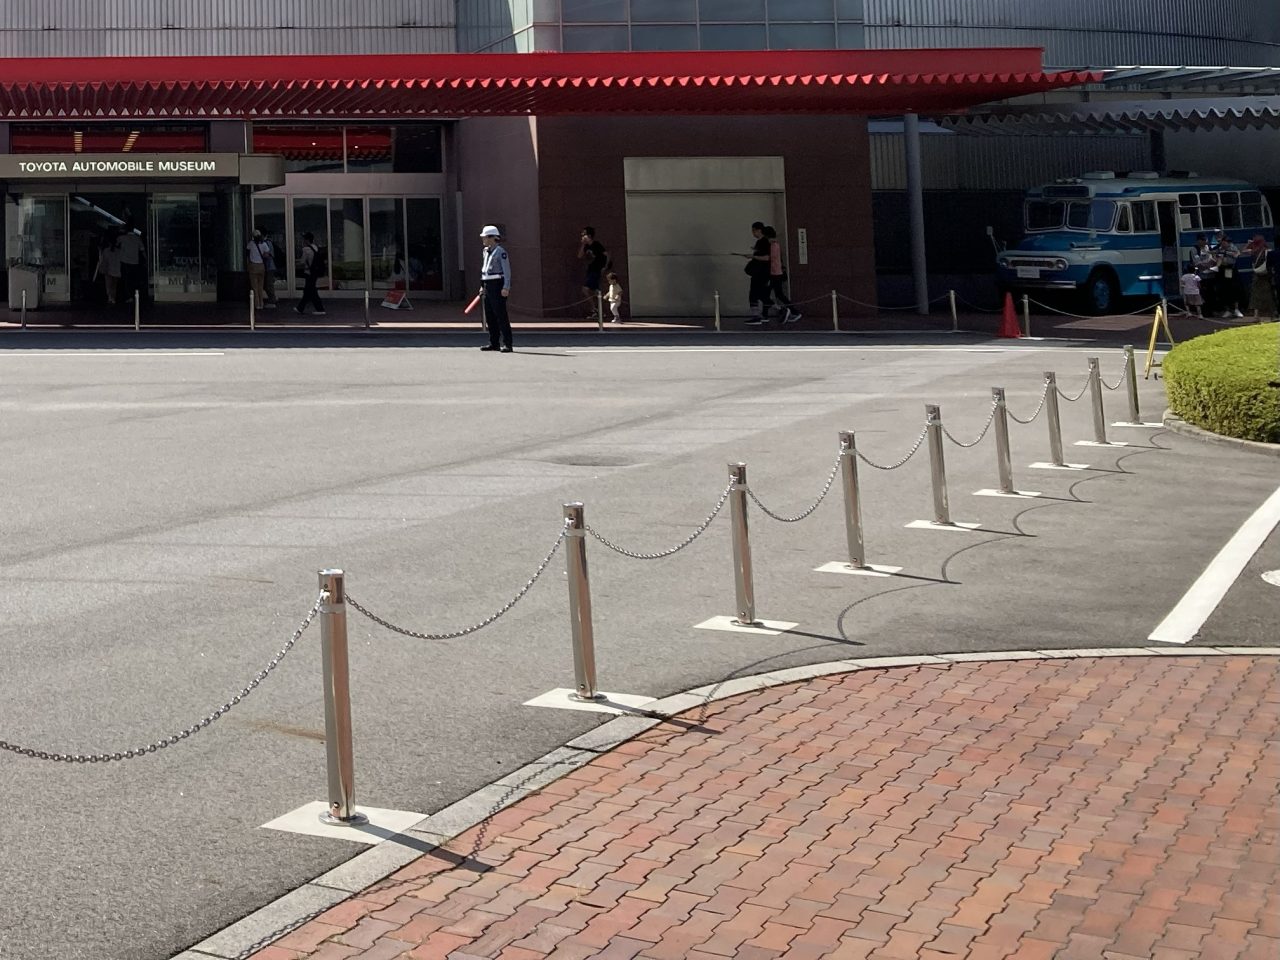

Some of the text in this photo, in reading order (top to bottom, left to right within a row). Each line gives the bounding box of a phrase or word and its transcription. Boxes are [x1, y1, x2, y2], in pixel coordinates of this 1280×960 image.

[19, 161, 216, 173] TOYOTA AUTOMOBILE MUSEUM
